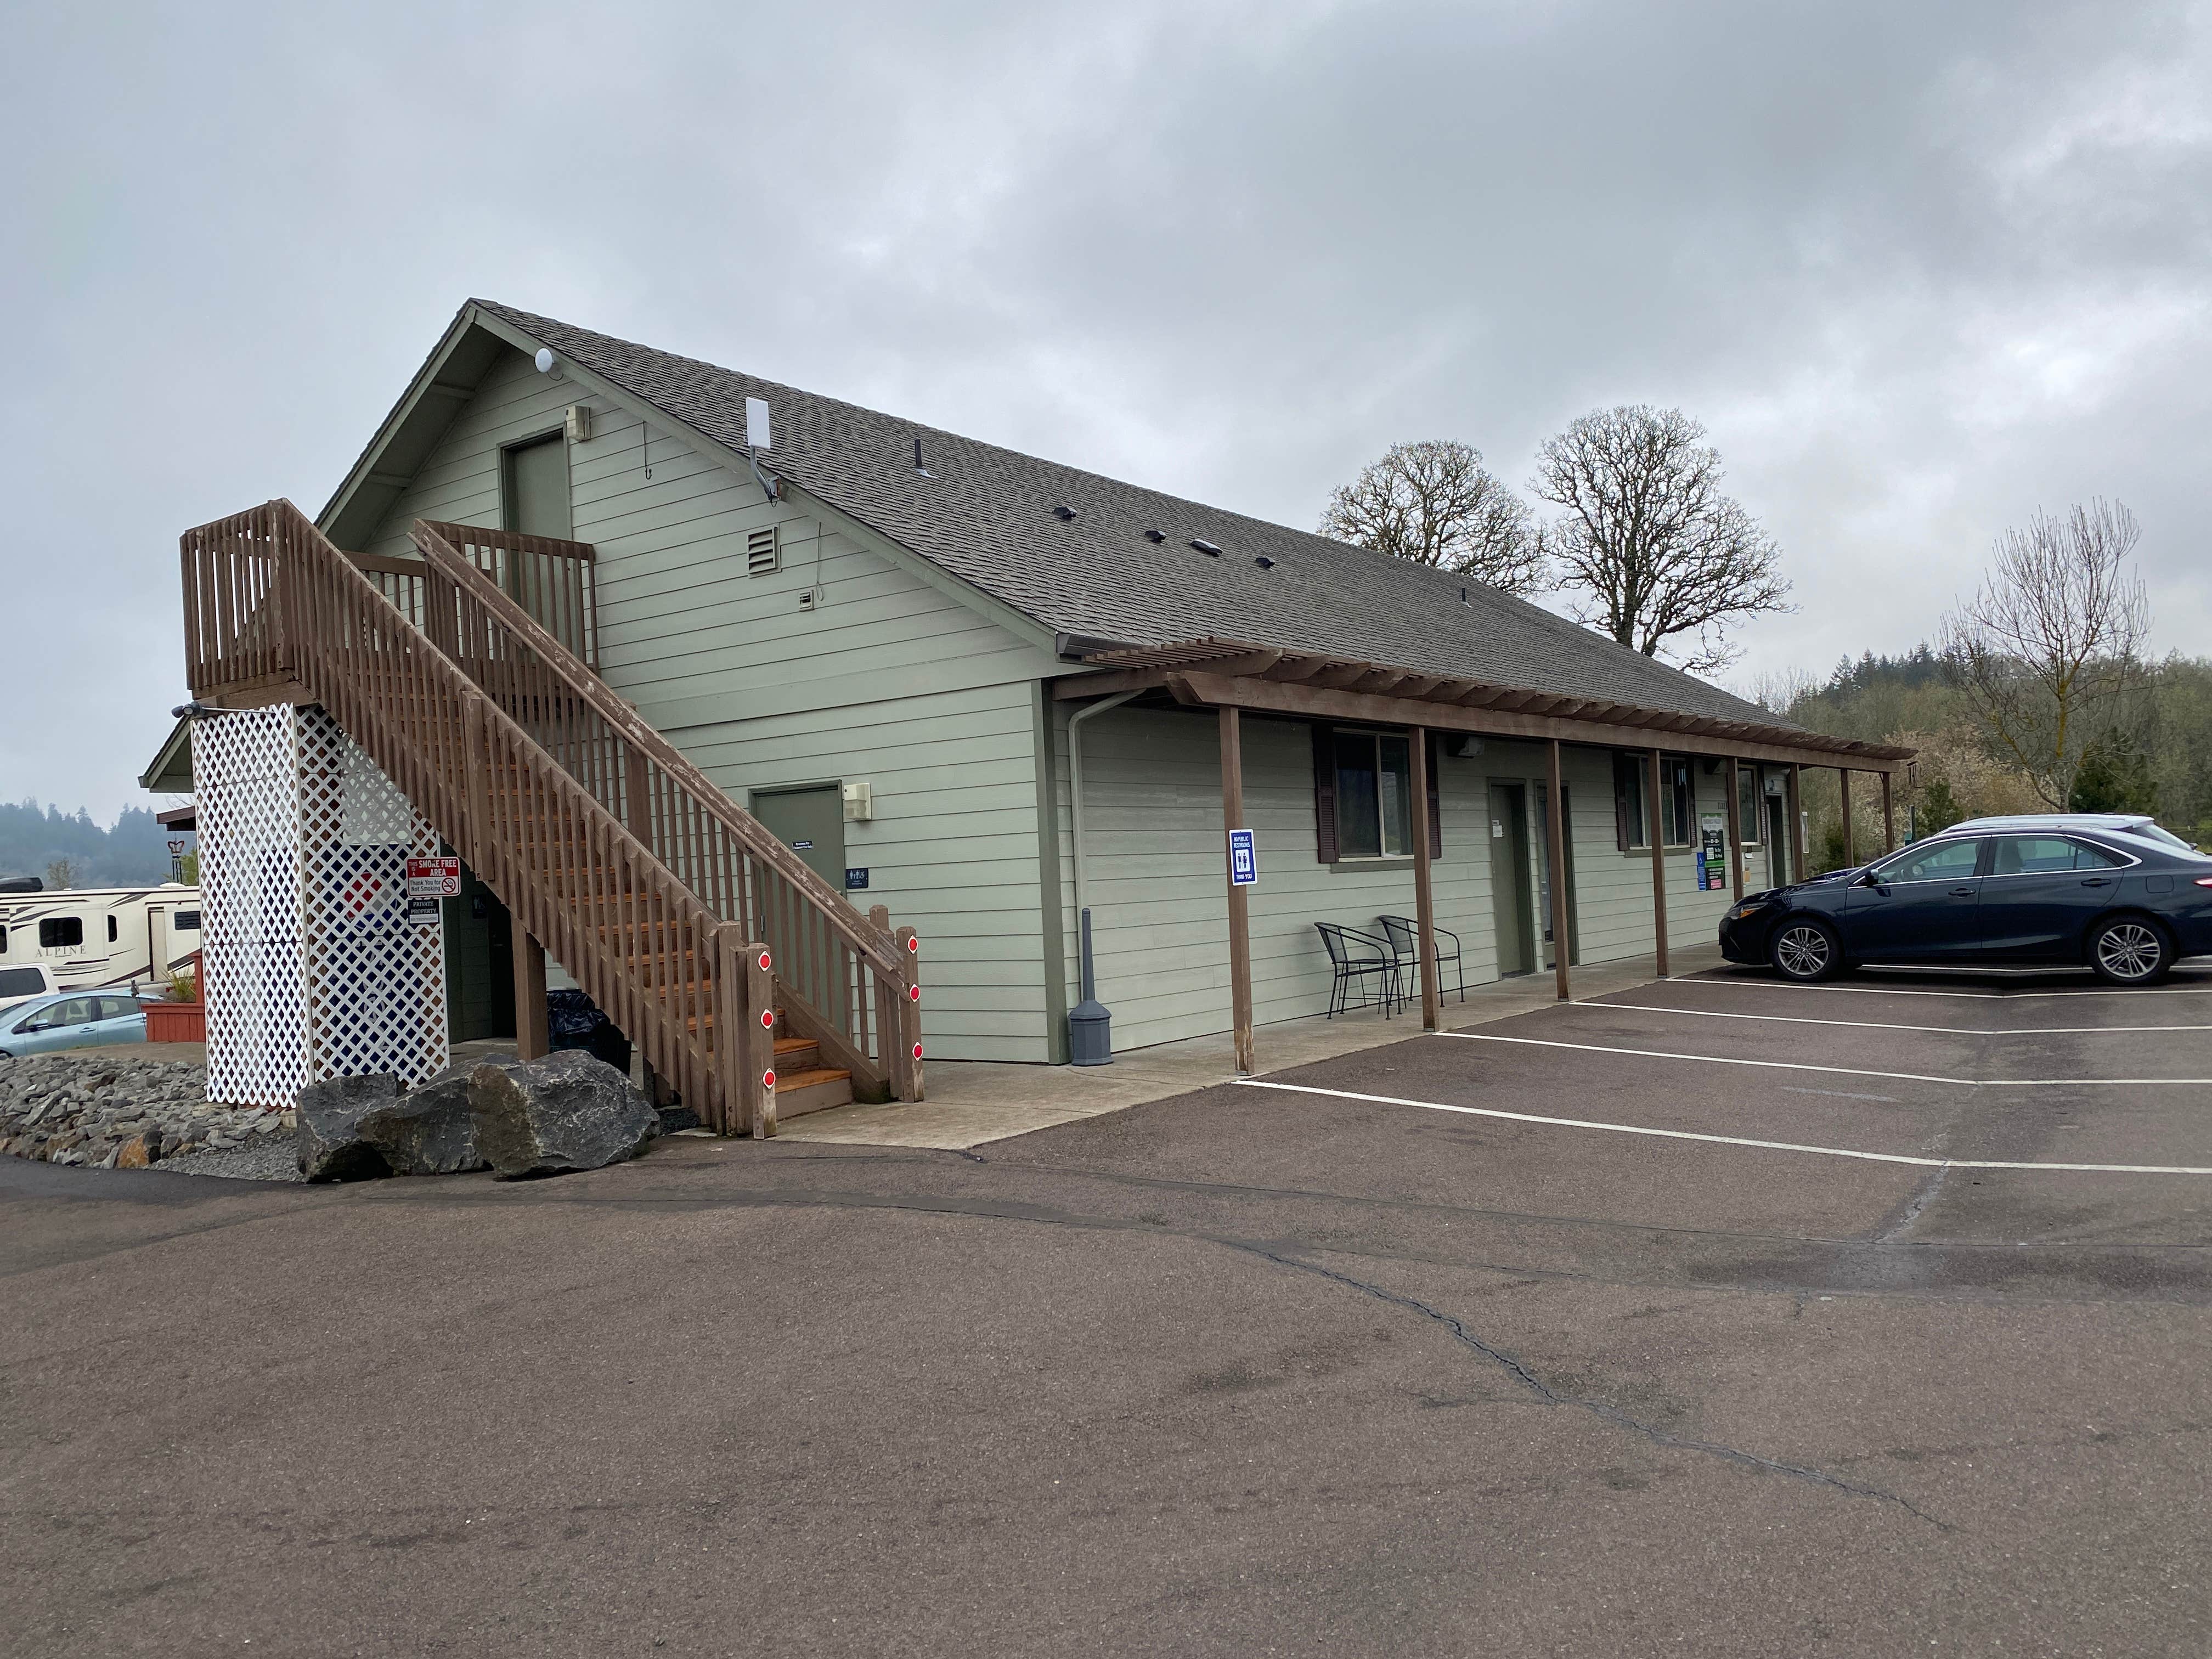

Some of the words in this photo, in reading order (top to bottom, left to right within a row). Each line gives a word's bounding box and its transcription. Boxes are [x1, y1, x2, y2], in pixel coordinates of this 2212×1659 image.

[441, 859, 456, 867] FREE
[430, 868, 447, 877] AREA
[35, 945, 86, 957] ALPINE
